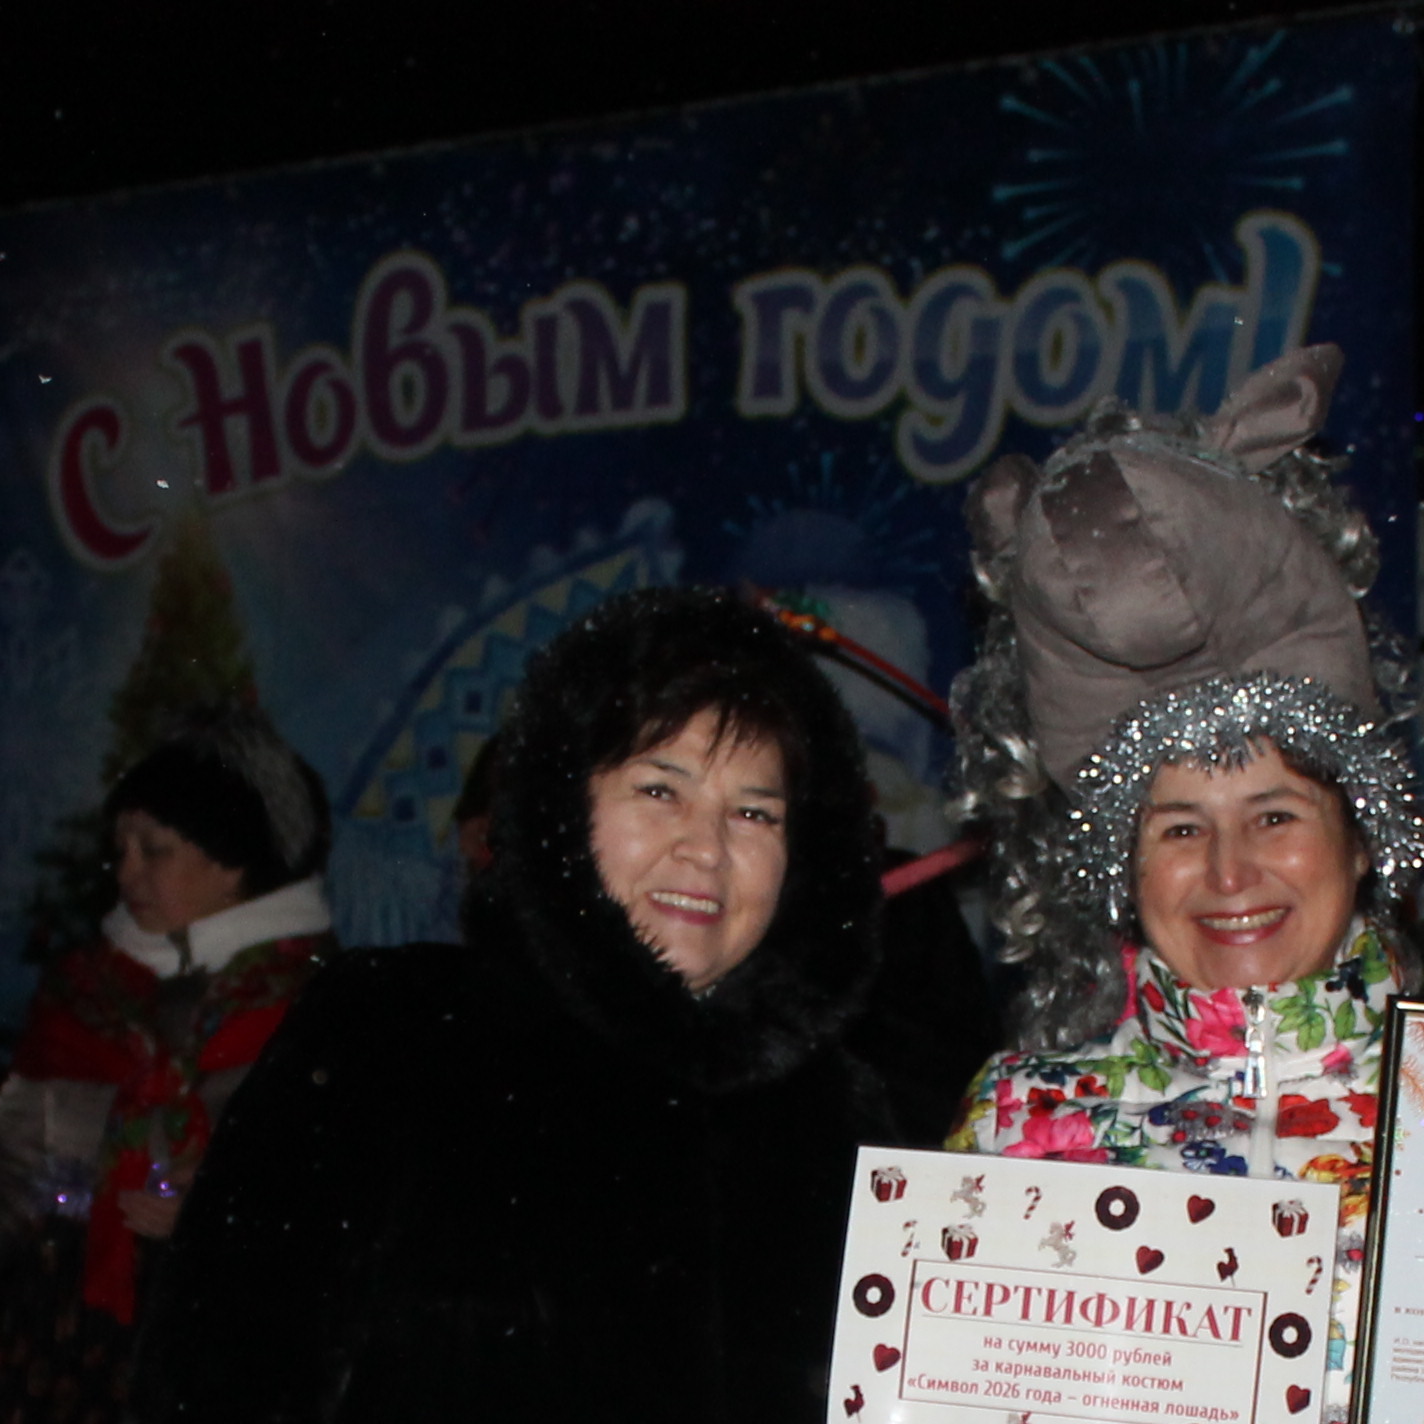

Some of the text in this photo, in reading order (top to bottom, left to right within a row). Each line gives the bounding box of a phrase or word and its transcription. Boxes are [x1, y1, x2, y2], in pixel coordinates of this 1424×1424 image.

[56, 403, 156, 564] С
[176, 252, 686, 498] Новым
[920, 1276, 1252, 1342] СЕРТИФИКАТ
[983, 1335, 1173, 1367] на сумму 3000 рублей
[907, 1374, 978, 1394] «Символ
[983, 1381, 1021, 1399] 2026
[1026, 1388, 1062, 1405] года
[1083, 1393, 1159, 1413] огненная
[1164, 1404, 1240, 1422] лошадь»
[972, 1359, 1184, 1392] за карнавальный костюм
